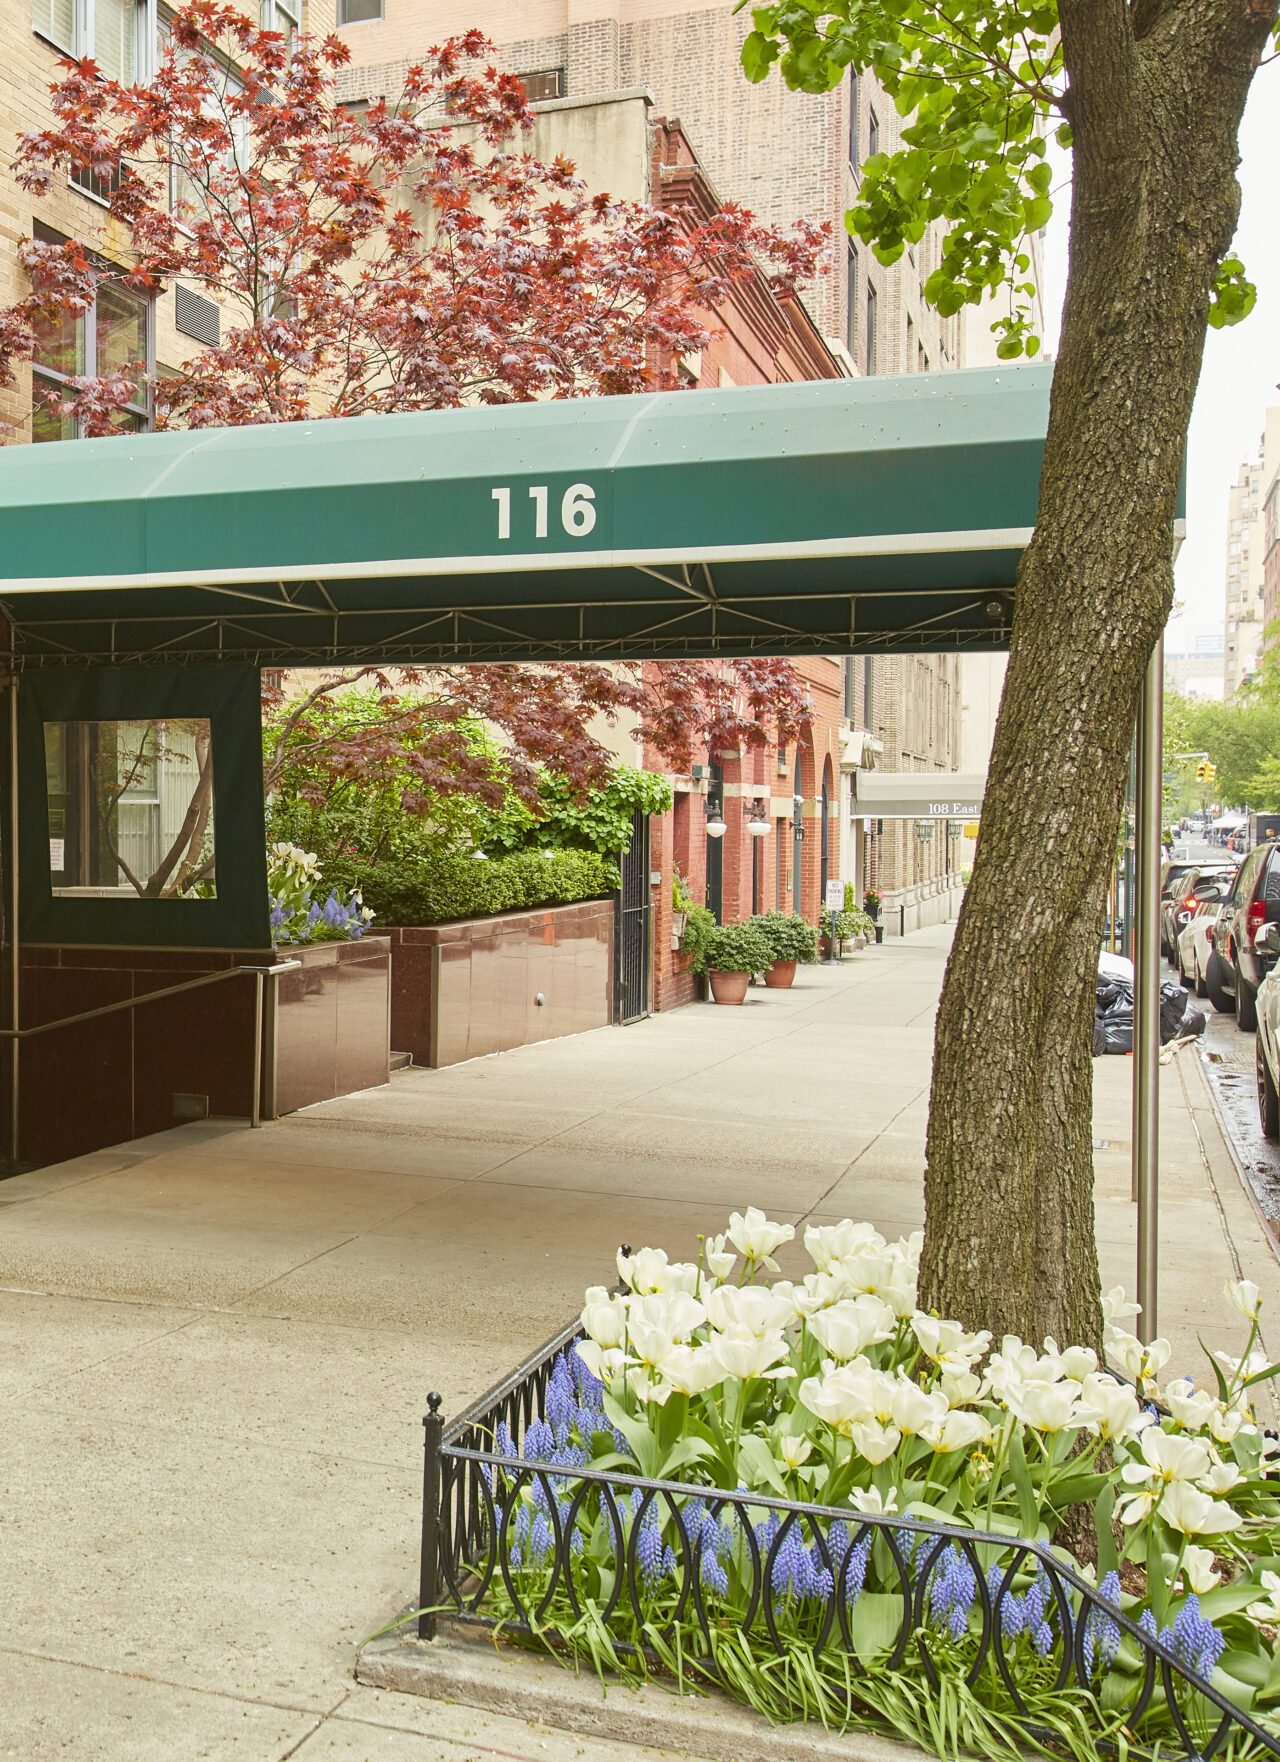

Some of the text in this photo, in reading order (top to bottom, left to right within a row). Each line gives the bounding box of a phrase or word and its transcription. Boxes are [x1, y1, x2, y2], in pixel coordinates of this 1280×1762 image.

[491, 483, 597, 539] 116
[928, 803, 978, 814] 108 East
